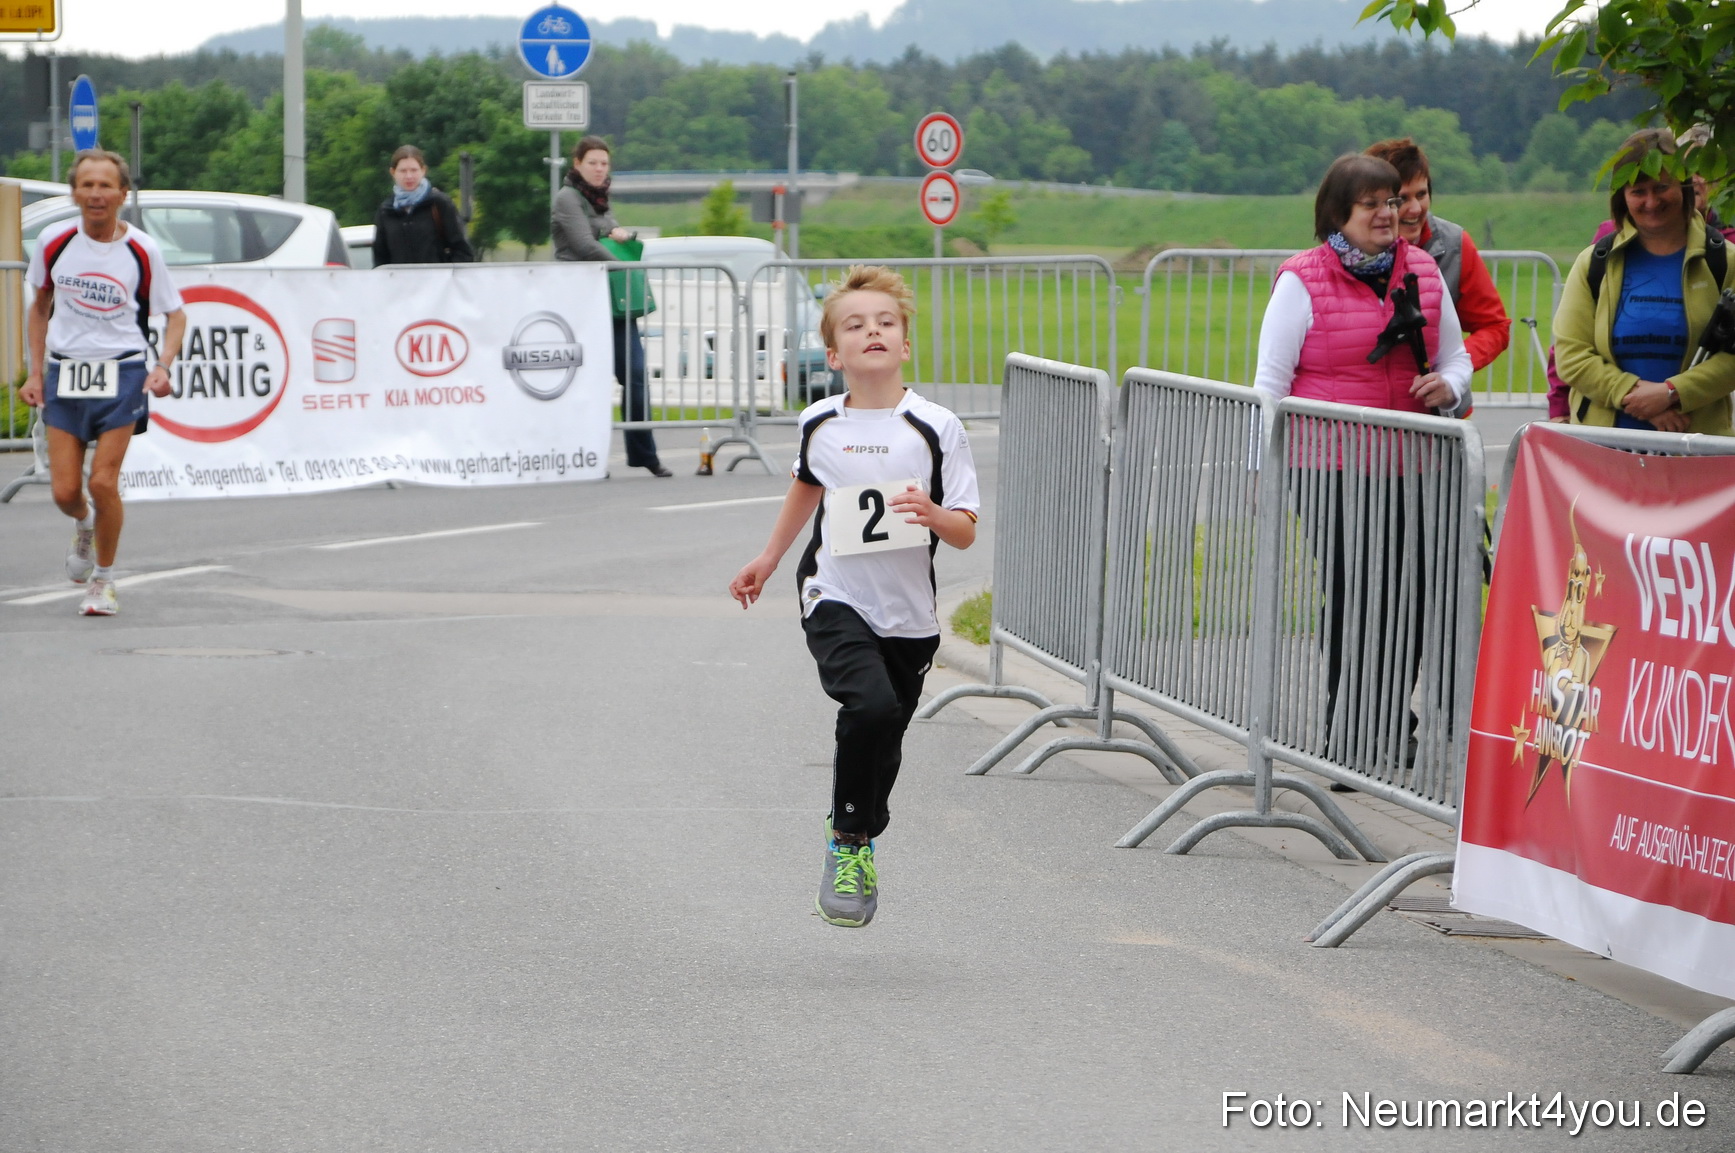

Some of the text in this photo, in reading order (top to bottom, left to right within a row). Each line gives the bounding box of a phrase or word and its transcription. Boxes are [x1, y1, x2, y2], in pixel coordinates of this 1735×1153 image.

[927, 128, 952, 152] 60
[57, 275, 116, 295] GERHART
[254, 333, 266, 351] &
[407, 333, 456, 363] KIA
[510, 348, 575, 364] NISSAN
[67, 362, 107, 391] 104
[171, 362, 271, 399] JÄNIG
[302, 393, 371, 410] SEAT
[385, 385, 486, 407] KIA MOTORS
[185, 462, 268, 490] Sengenthal
[276, 460, 303, 482] Tel.
[419, 447, 598, 480] www.gerhart-jaenig.de
[858, 488, 889, 543] 2
[1610, 813, 1639, 852] AUF
